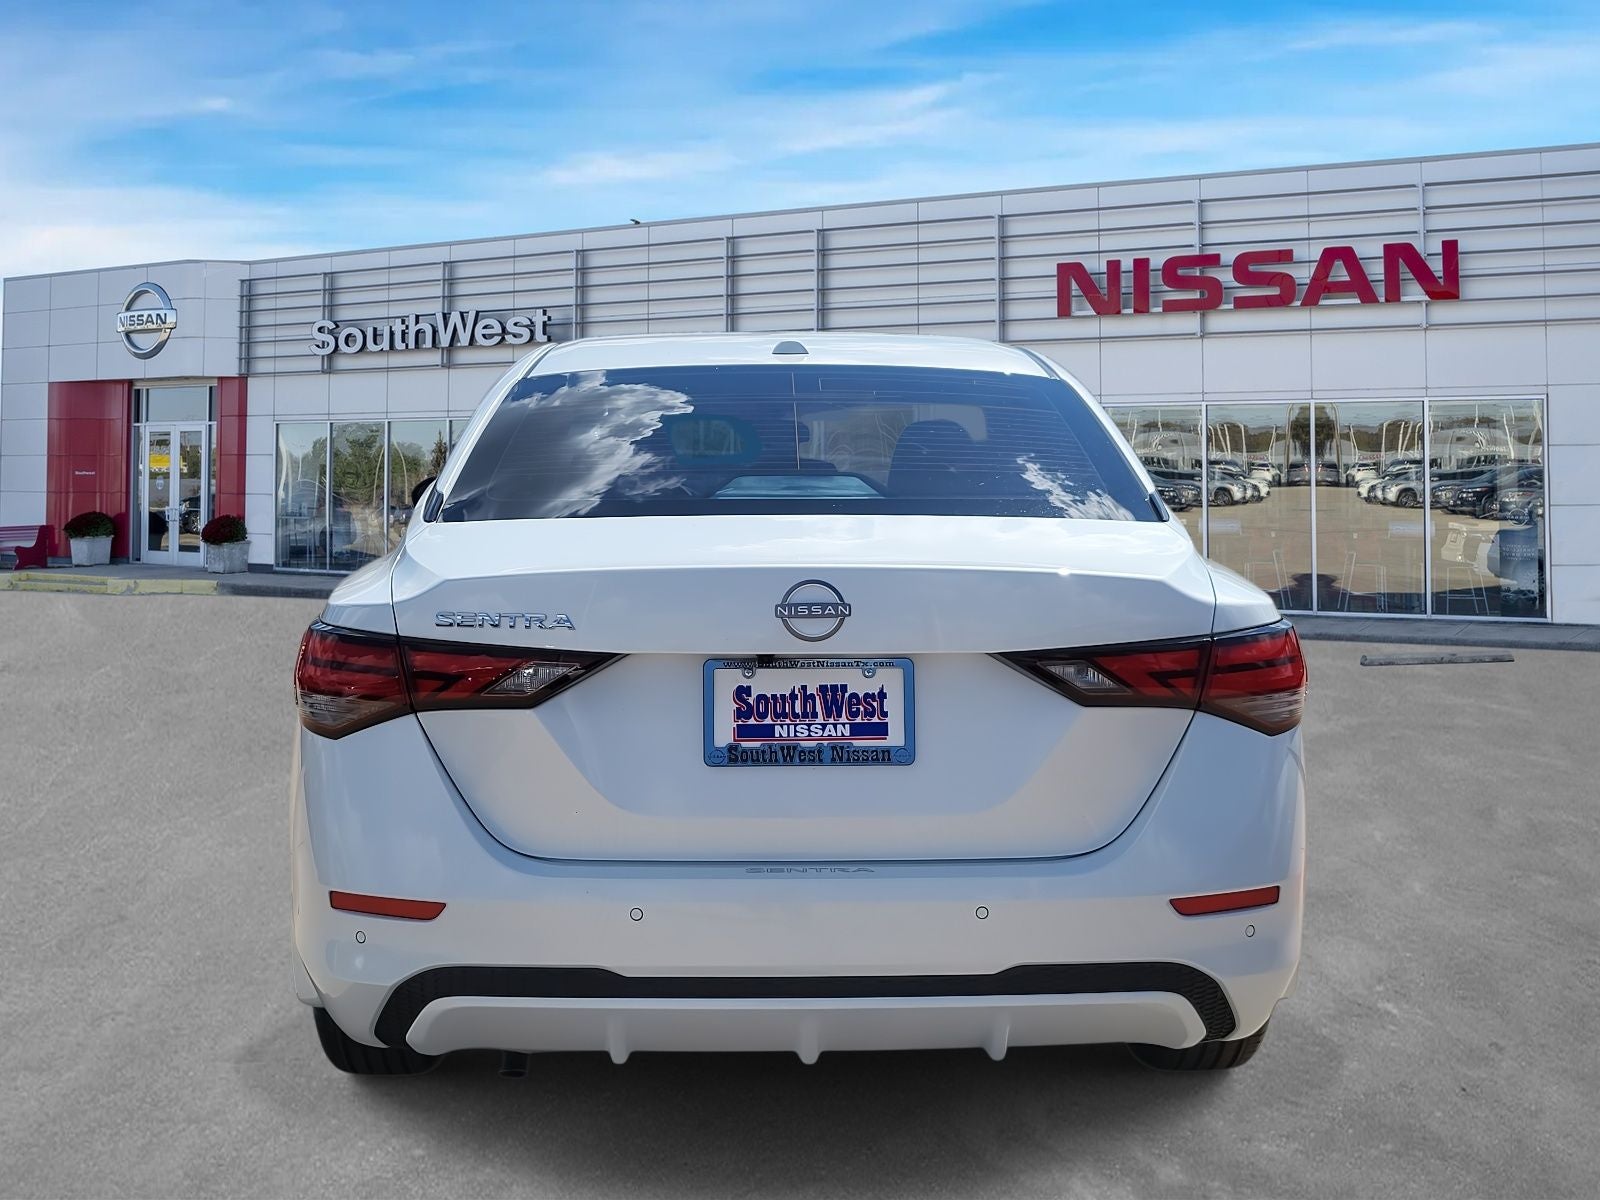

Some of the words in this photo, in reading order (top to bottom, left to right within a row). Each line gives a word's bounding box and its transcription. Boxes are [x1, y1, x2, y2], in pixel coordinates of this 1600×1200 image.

[1057, 239, 1460, 318] NISSAN
[119, 312, 168, 328] NISSAN
[309, 309, 552, 356] SouthWest
[777, 605, 850, 616] NISSAN
[435, 611, 576, 631] SENTRA
[732, 684, 889, 722] SouthWest
[774, 724, 851, 738] NISSAN
[727, 745, 825, 764] SouthWest
[831, 745, 892, 764] Nissan
[745, 866, 876, 874] SENTRA
